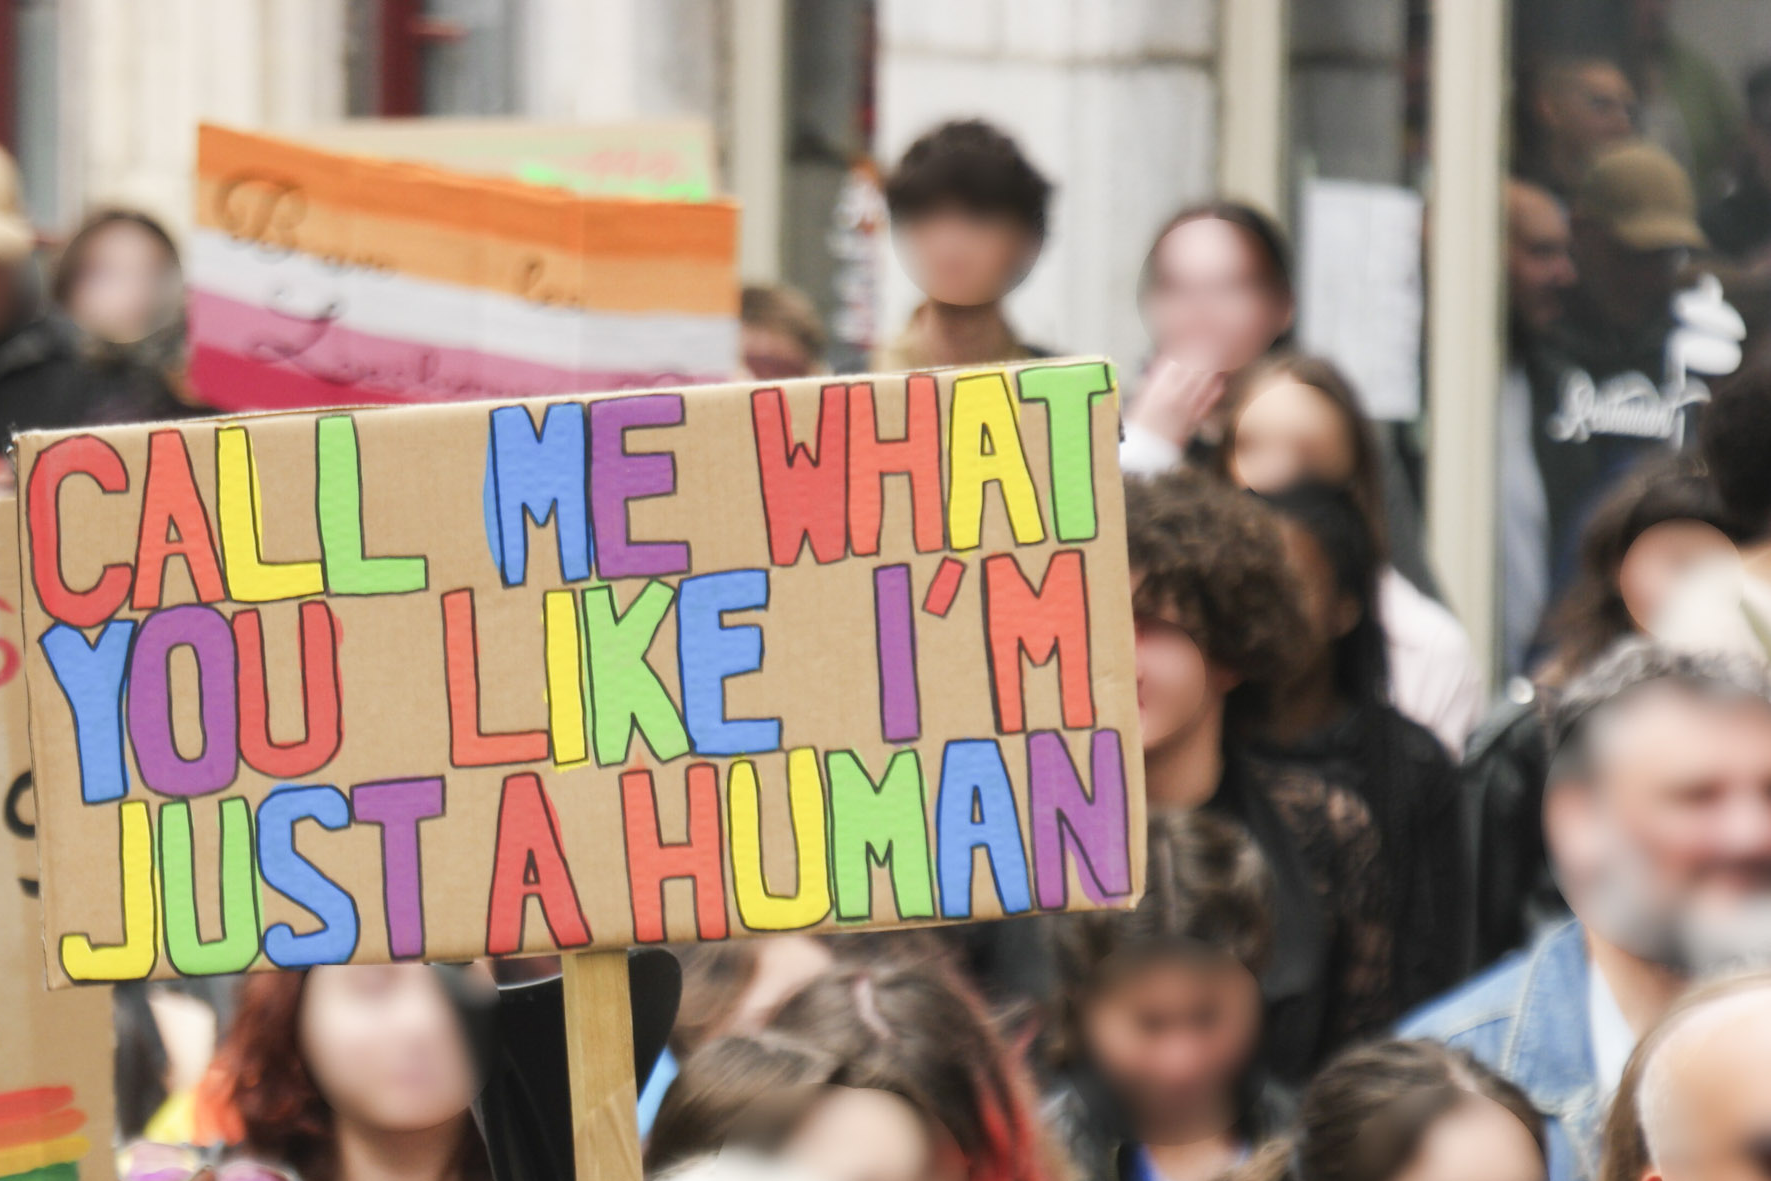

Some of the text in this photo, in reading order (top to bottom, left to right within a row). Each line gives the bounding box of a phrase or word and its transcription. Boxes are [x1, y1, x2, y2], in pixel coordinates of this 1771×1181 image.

[29, 362, 1114, 628] CALL ME WHAT
[39, 550, 1096, 804] YOU LIKE I'M
[60, 729, 1131, 982] JUST A HUMAN
